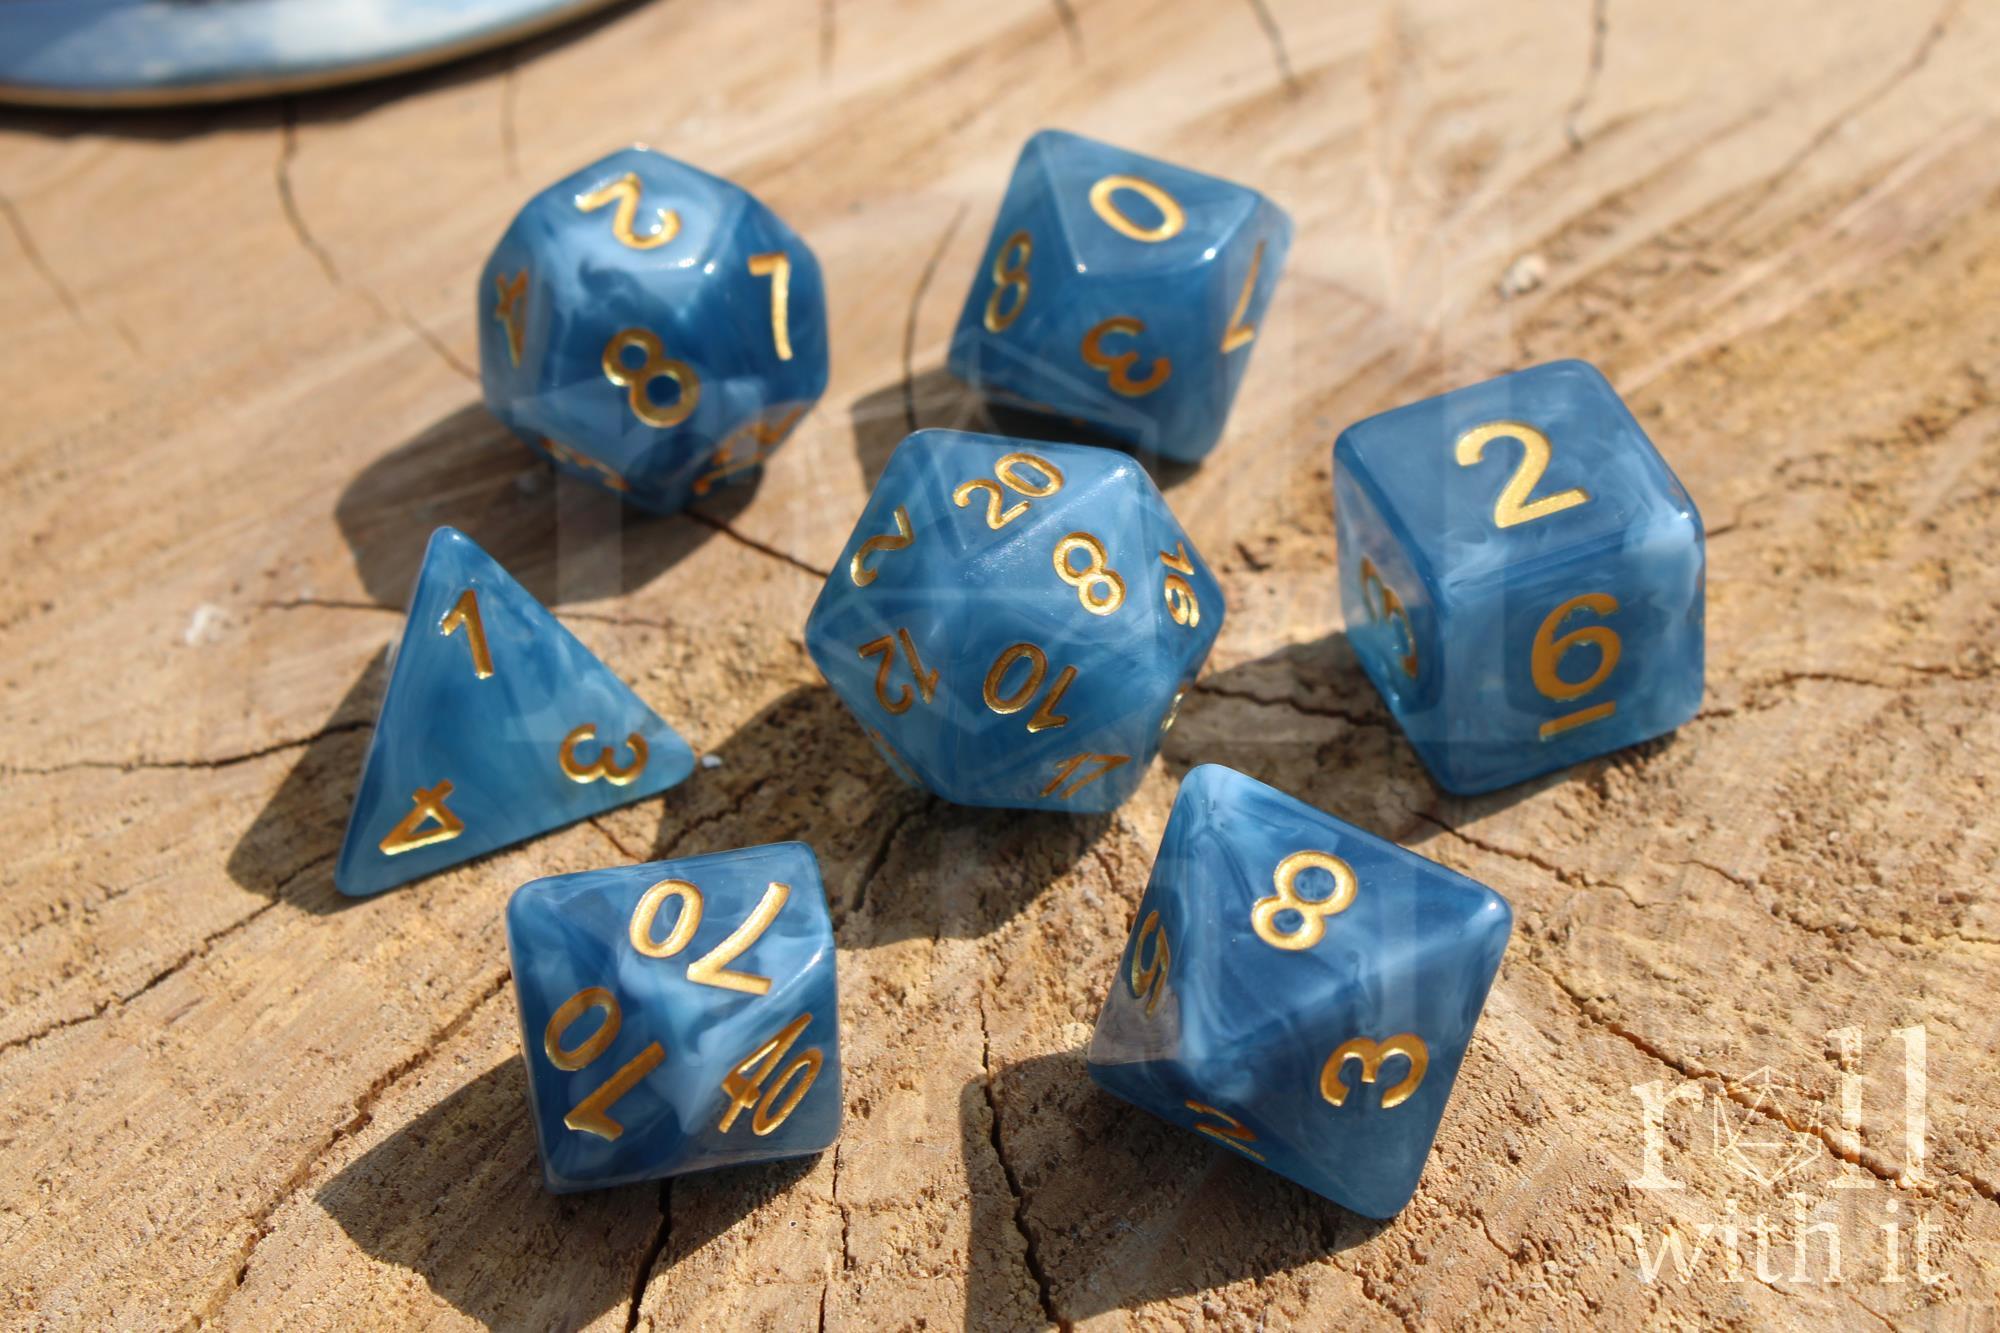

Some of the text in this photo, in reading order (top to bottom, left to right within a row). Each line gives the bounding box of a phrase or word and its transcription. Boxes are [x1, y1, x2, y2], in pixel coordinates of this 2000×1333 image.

[574, 171, 683, 249] 2
[1088, 173, 1187, 243] 0
[495, 266, 529, 369] 4
[748, 252, 793, 361] 7
[983, 229, 1033, 334] 8
[602, 327, 701, 429] 8
[1080, 315, 1172, 396] 3
[952, 452, 1064, 530] 20
[1454, 419, 1591, 528] 2
[850, 504, 914, 587] 2
[1052, 531, 1126, 617] 8
[1159, 541, 1200, 629] 16
[437, 589, 495, 680] 1
[857, 627, 940, 716] 12
[982, 642, 1078, 735] 10
[559, 722, 649, 787] 3
[1039, 752, 1132, 800] 17
[378, 779, 465, 857] 4
[629, 878, 793, 996] 70
[1250, 849, 1358, 951] 8
[543, 986, 667, 1143] 10
[721, 1012, 824, 1137] 40
[1319, 1032, 1430, 1110] 3
